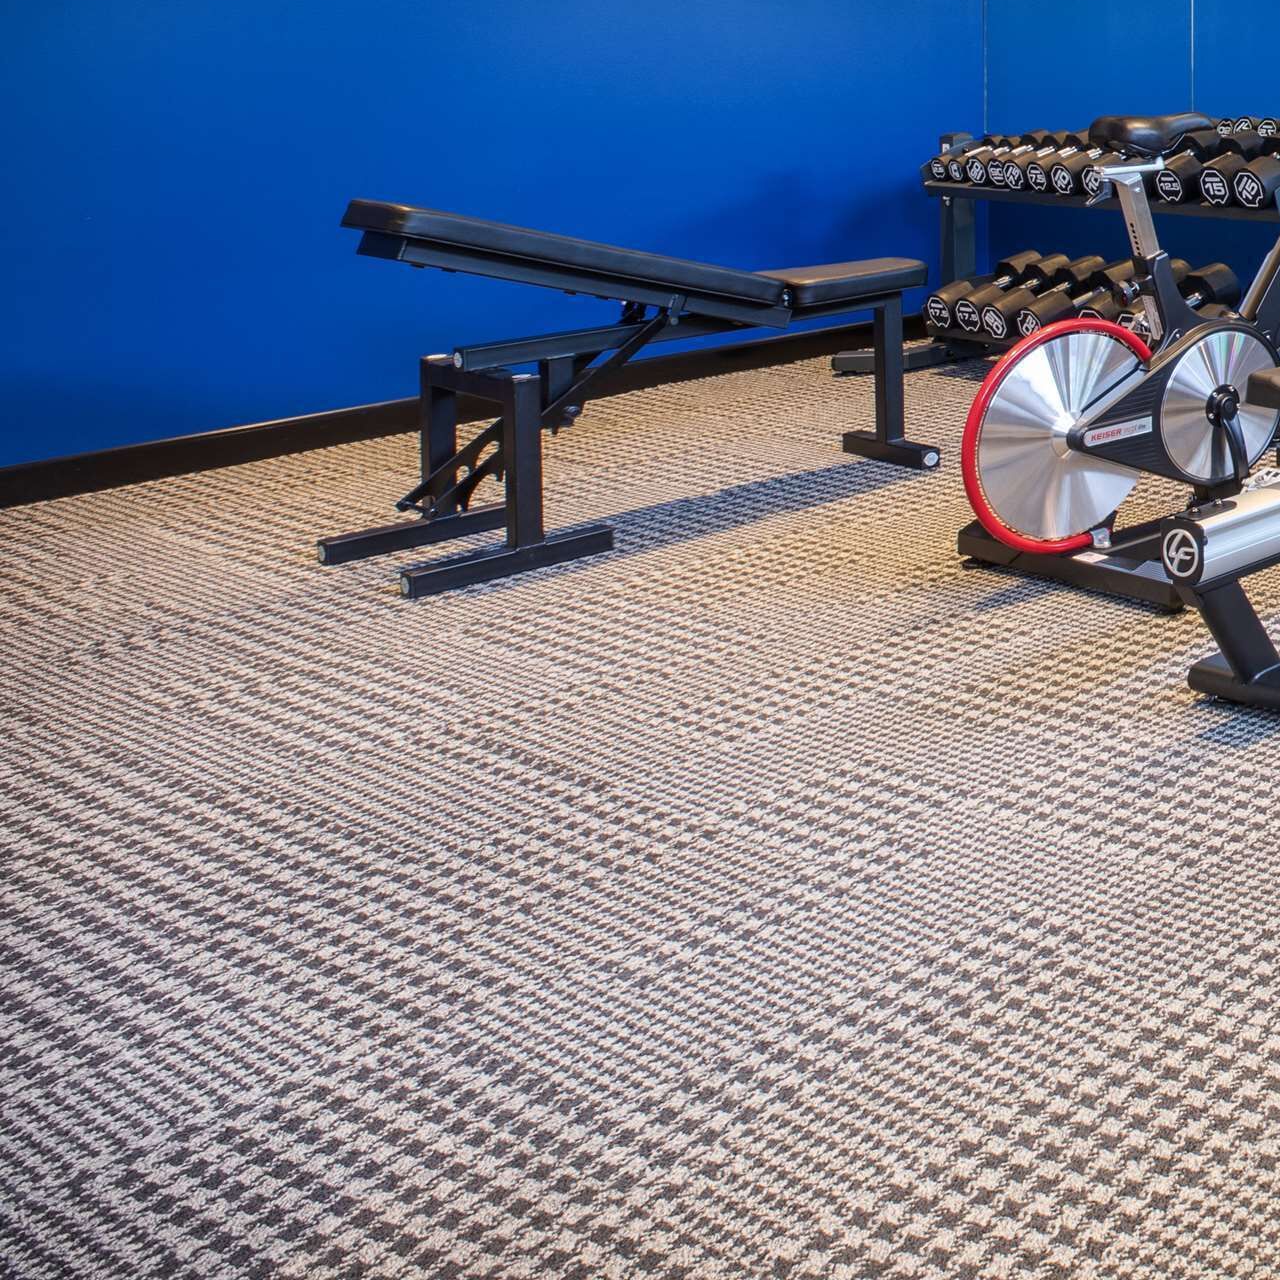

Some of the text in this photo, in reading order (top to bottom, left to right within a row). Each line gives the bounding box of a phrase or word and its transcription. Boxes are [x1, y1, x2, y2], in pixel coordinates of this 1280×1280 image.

[1160, 182, 1180, 191] 12.5
[1204, 183, 1224, 195] 15
[1091, 429, 1122, 441] KEISER
